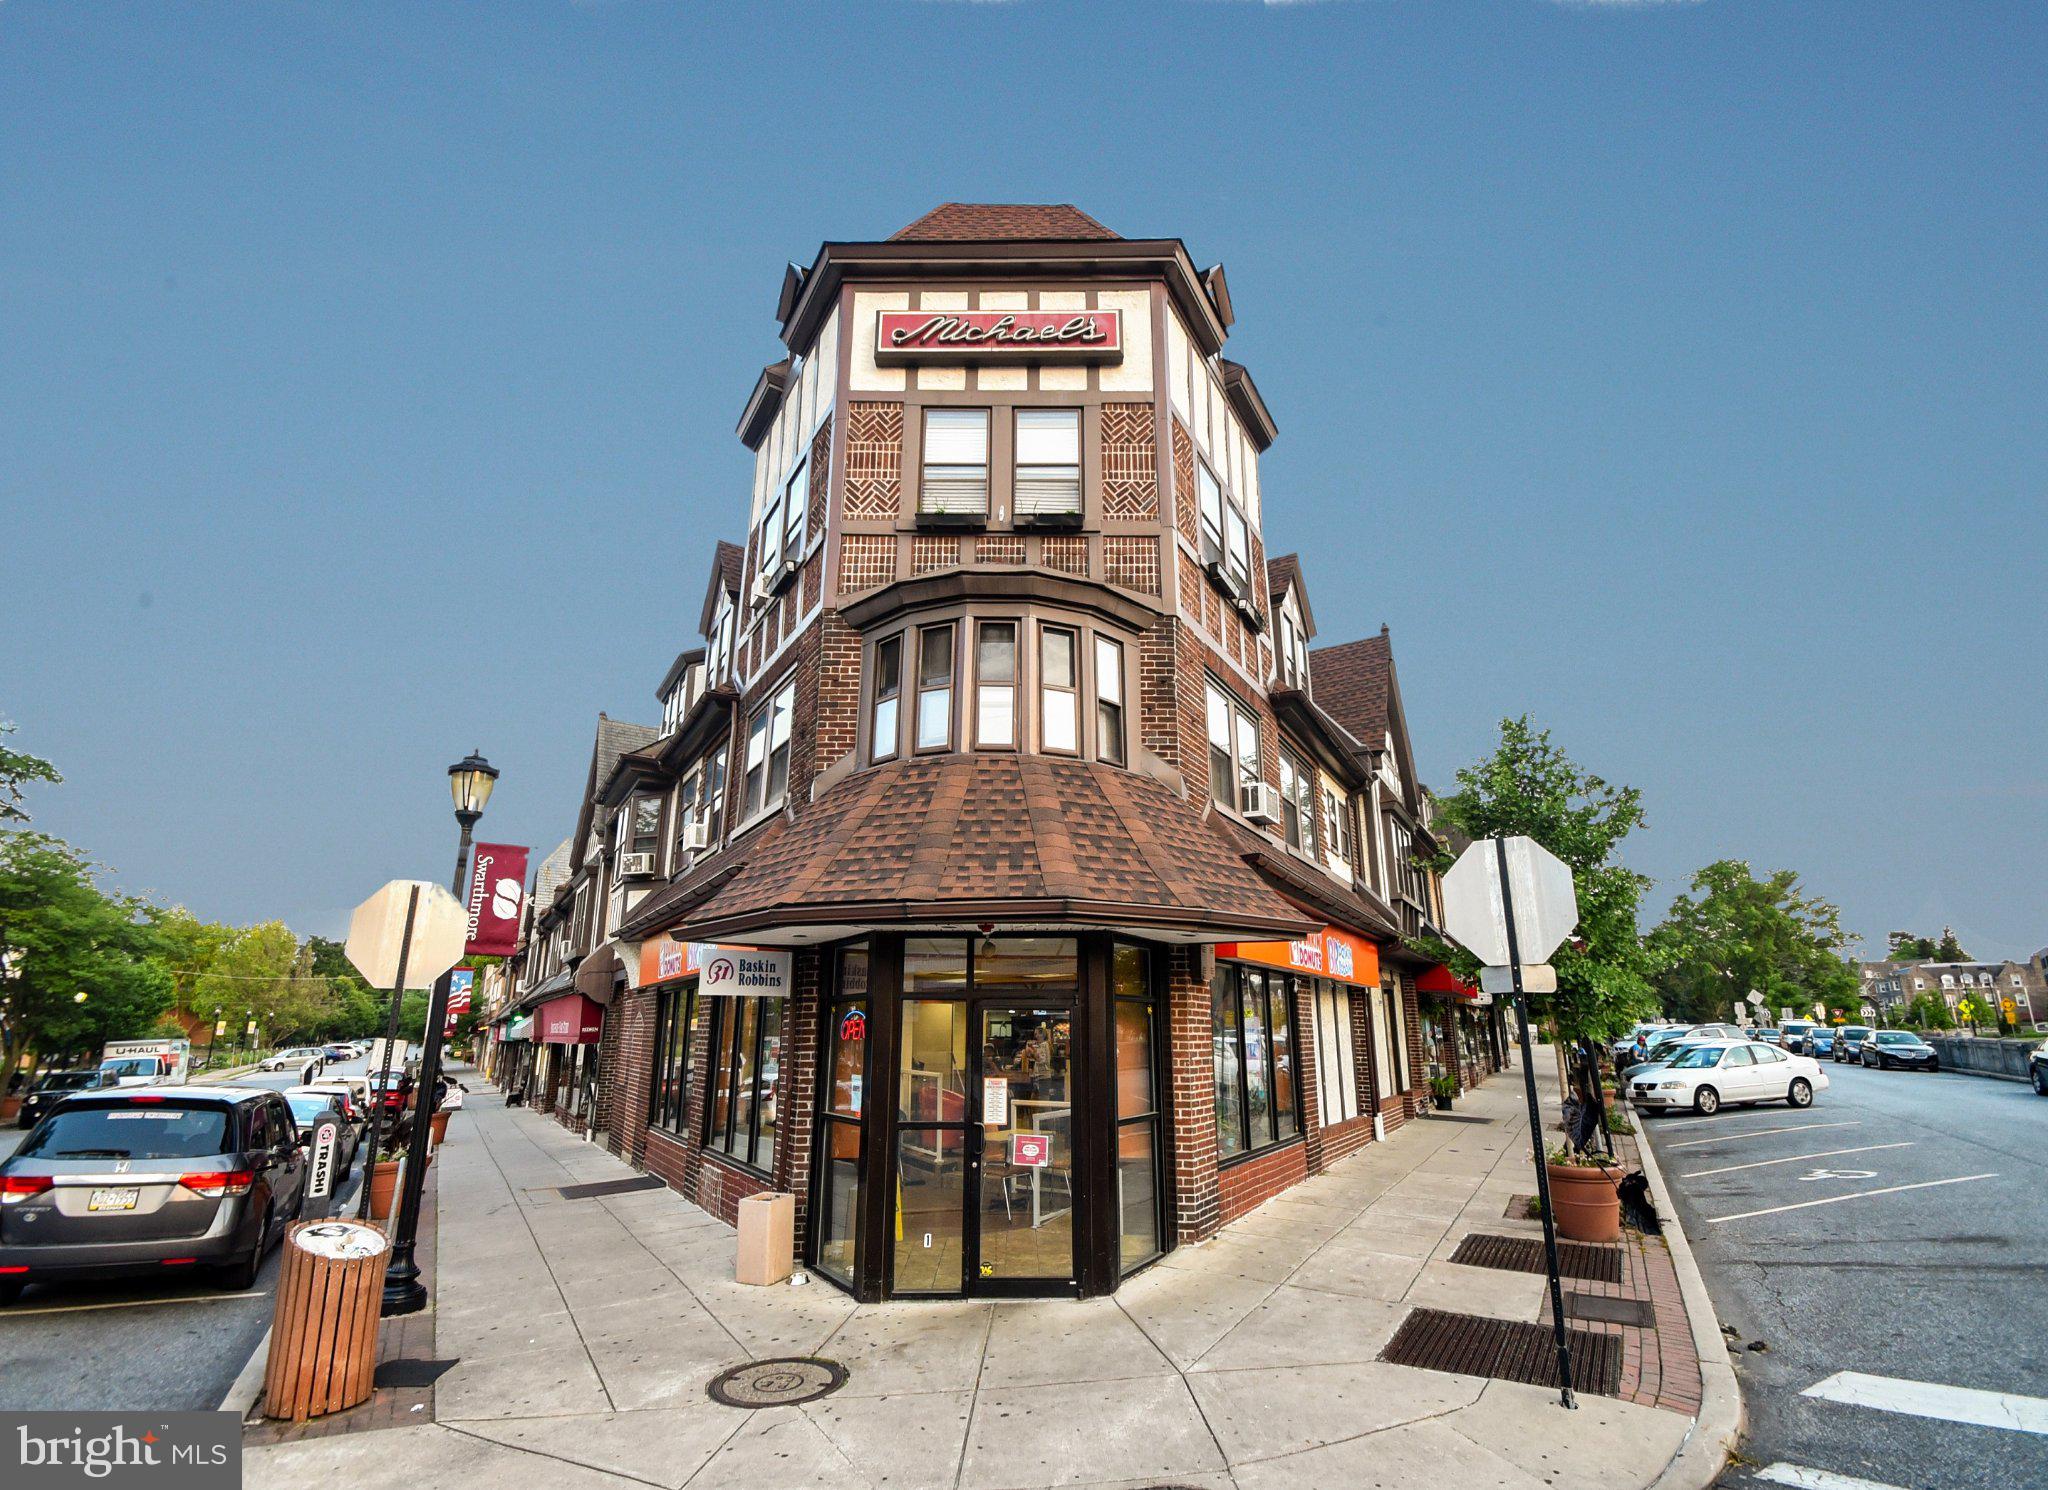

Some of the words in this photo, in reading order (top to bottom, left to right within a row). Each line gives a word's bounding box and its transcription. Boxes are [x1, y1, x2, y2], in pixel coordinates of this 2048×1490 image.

[466, 854, 494, 941] Swarthmore
[739, 958, 777, 973] Baskin
[738, 973, 782, 987] Robbins
[115, 1046, 161, 1055] U-HAUL
[315, 1144, 330, 1187] TRASH
